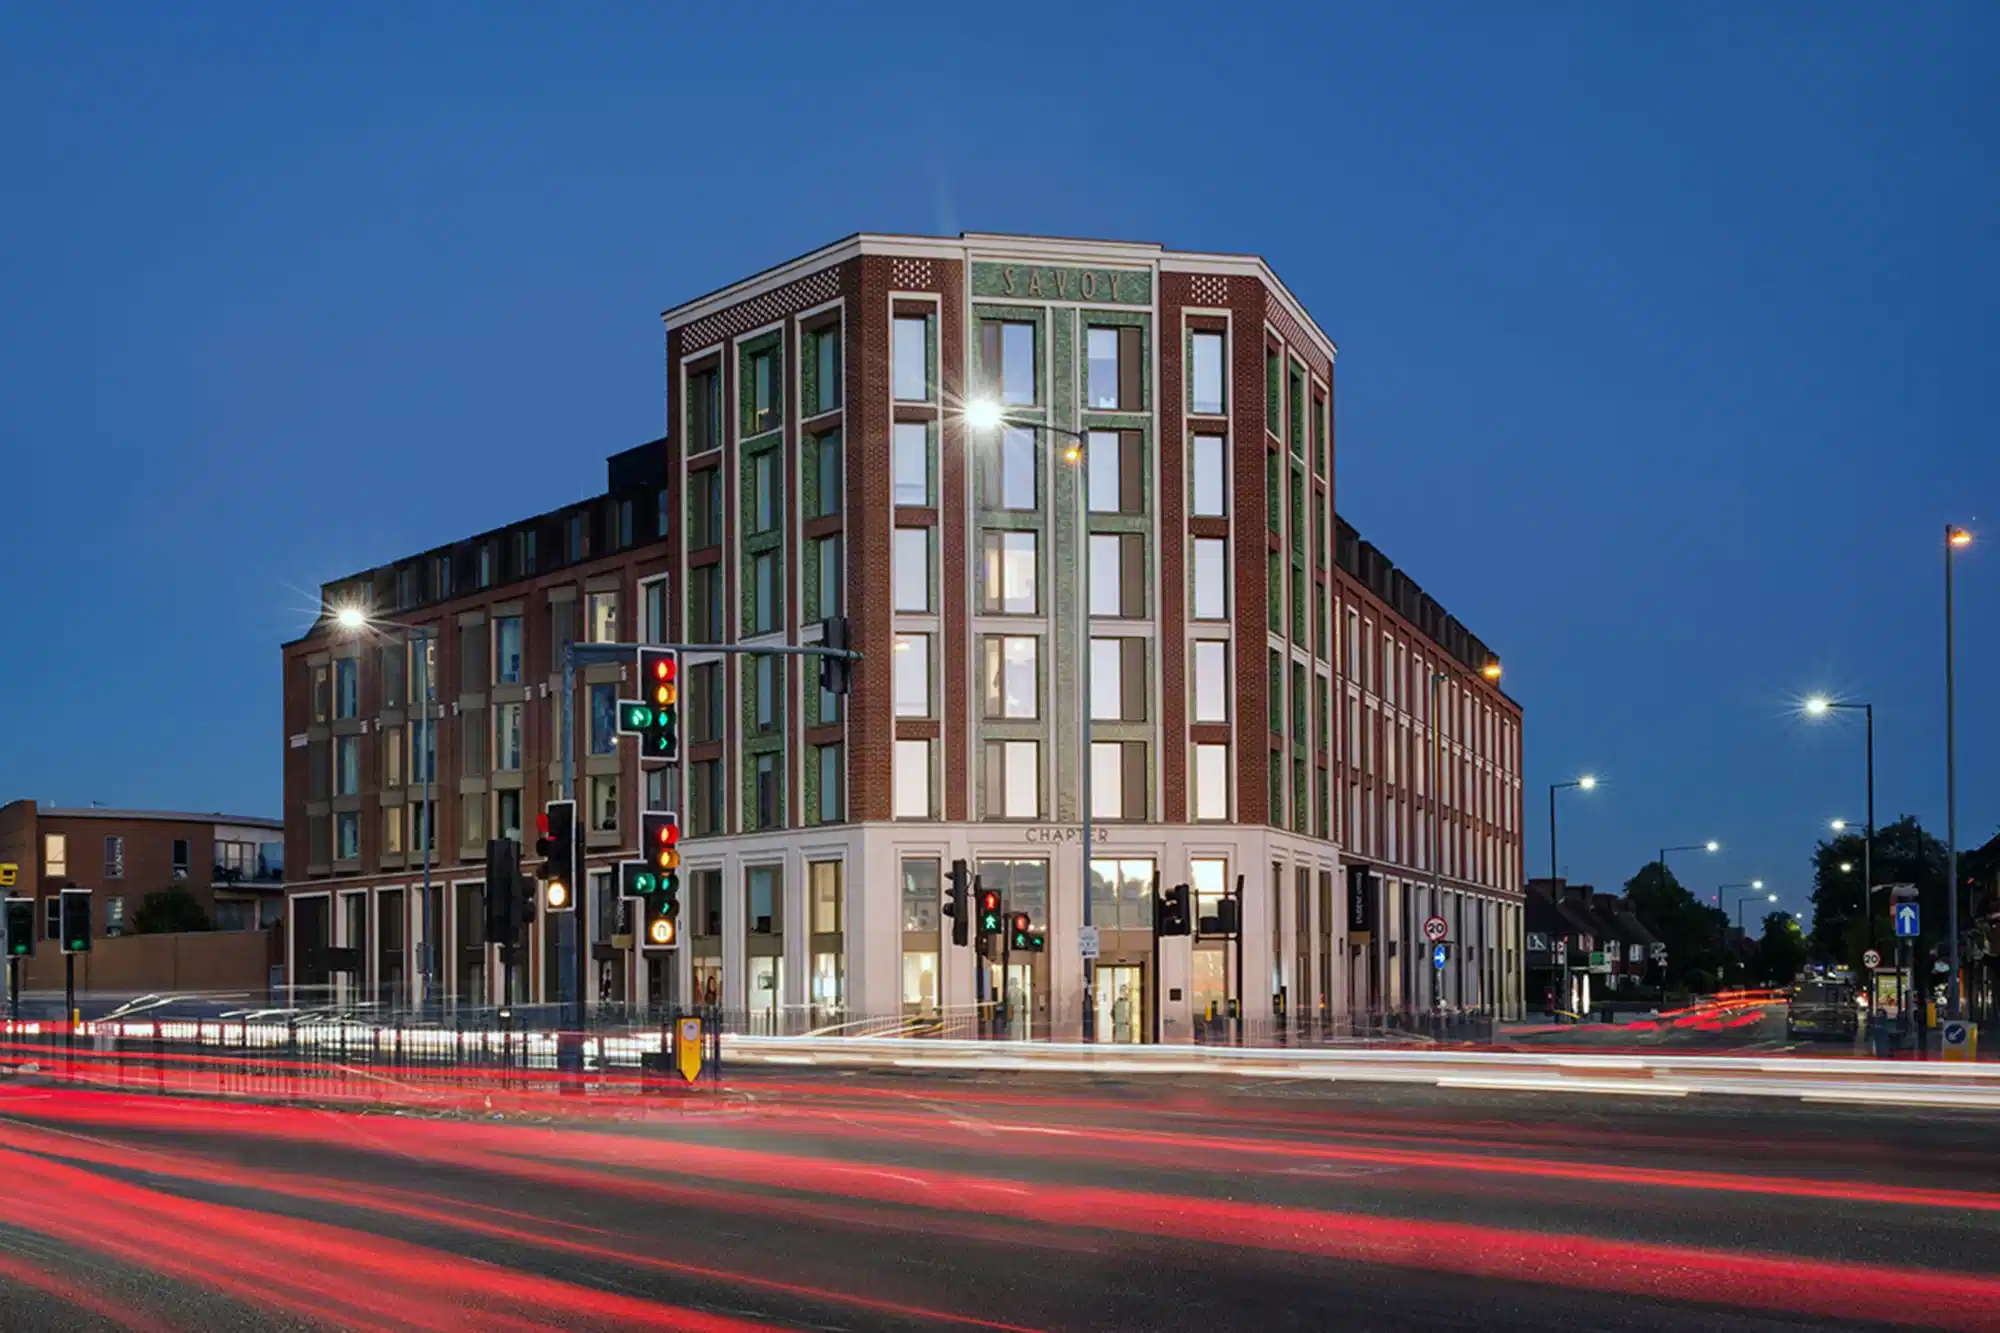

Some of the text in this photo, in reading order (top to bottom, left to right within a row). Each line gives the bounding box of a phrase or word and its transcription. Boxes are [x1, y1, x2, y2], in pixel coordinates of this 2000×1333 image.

[1003, 267, 1121, 301] SAVOY
[1427, 922, 1445, 934] 20
[1864, 954, 1878, 964] 20
